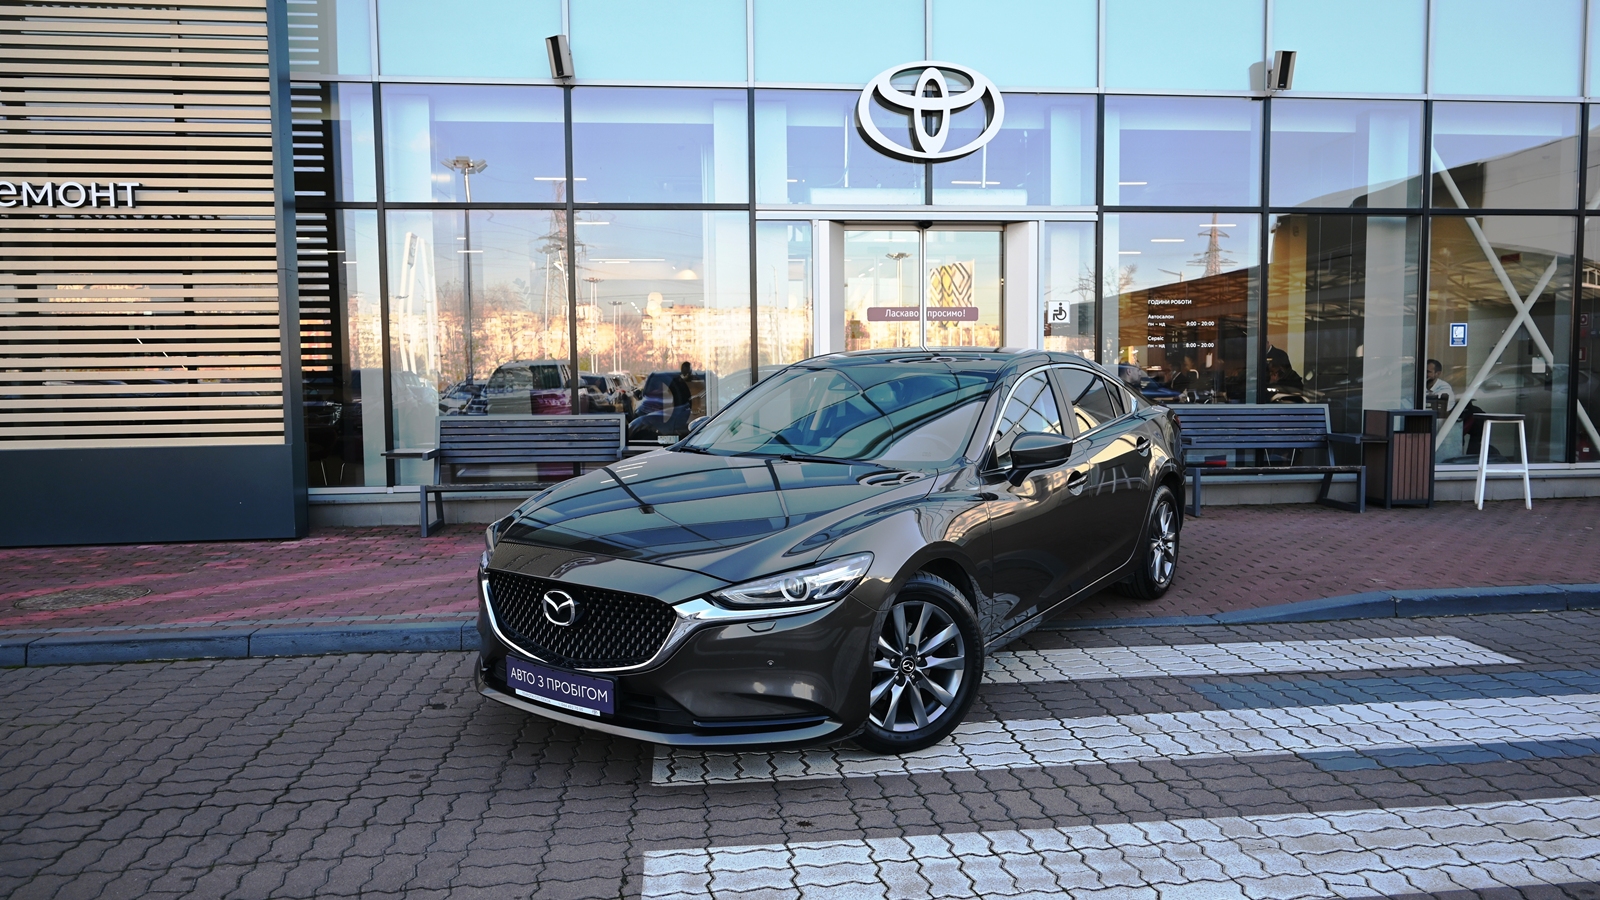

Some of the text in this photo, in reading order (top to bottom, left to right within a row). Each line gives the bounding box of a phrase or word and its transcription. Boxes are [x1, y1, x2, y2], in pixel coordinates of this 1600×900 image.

[885, 309, 966, 319] Ласкаво просимо!
[510, 667, 536, 685] АВТО
[546, 678, 608, 703] ПРОБІГОМ
